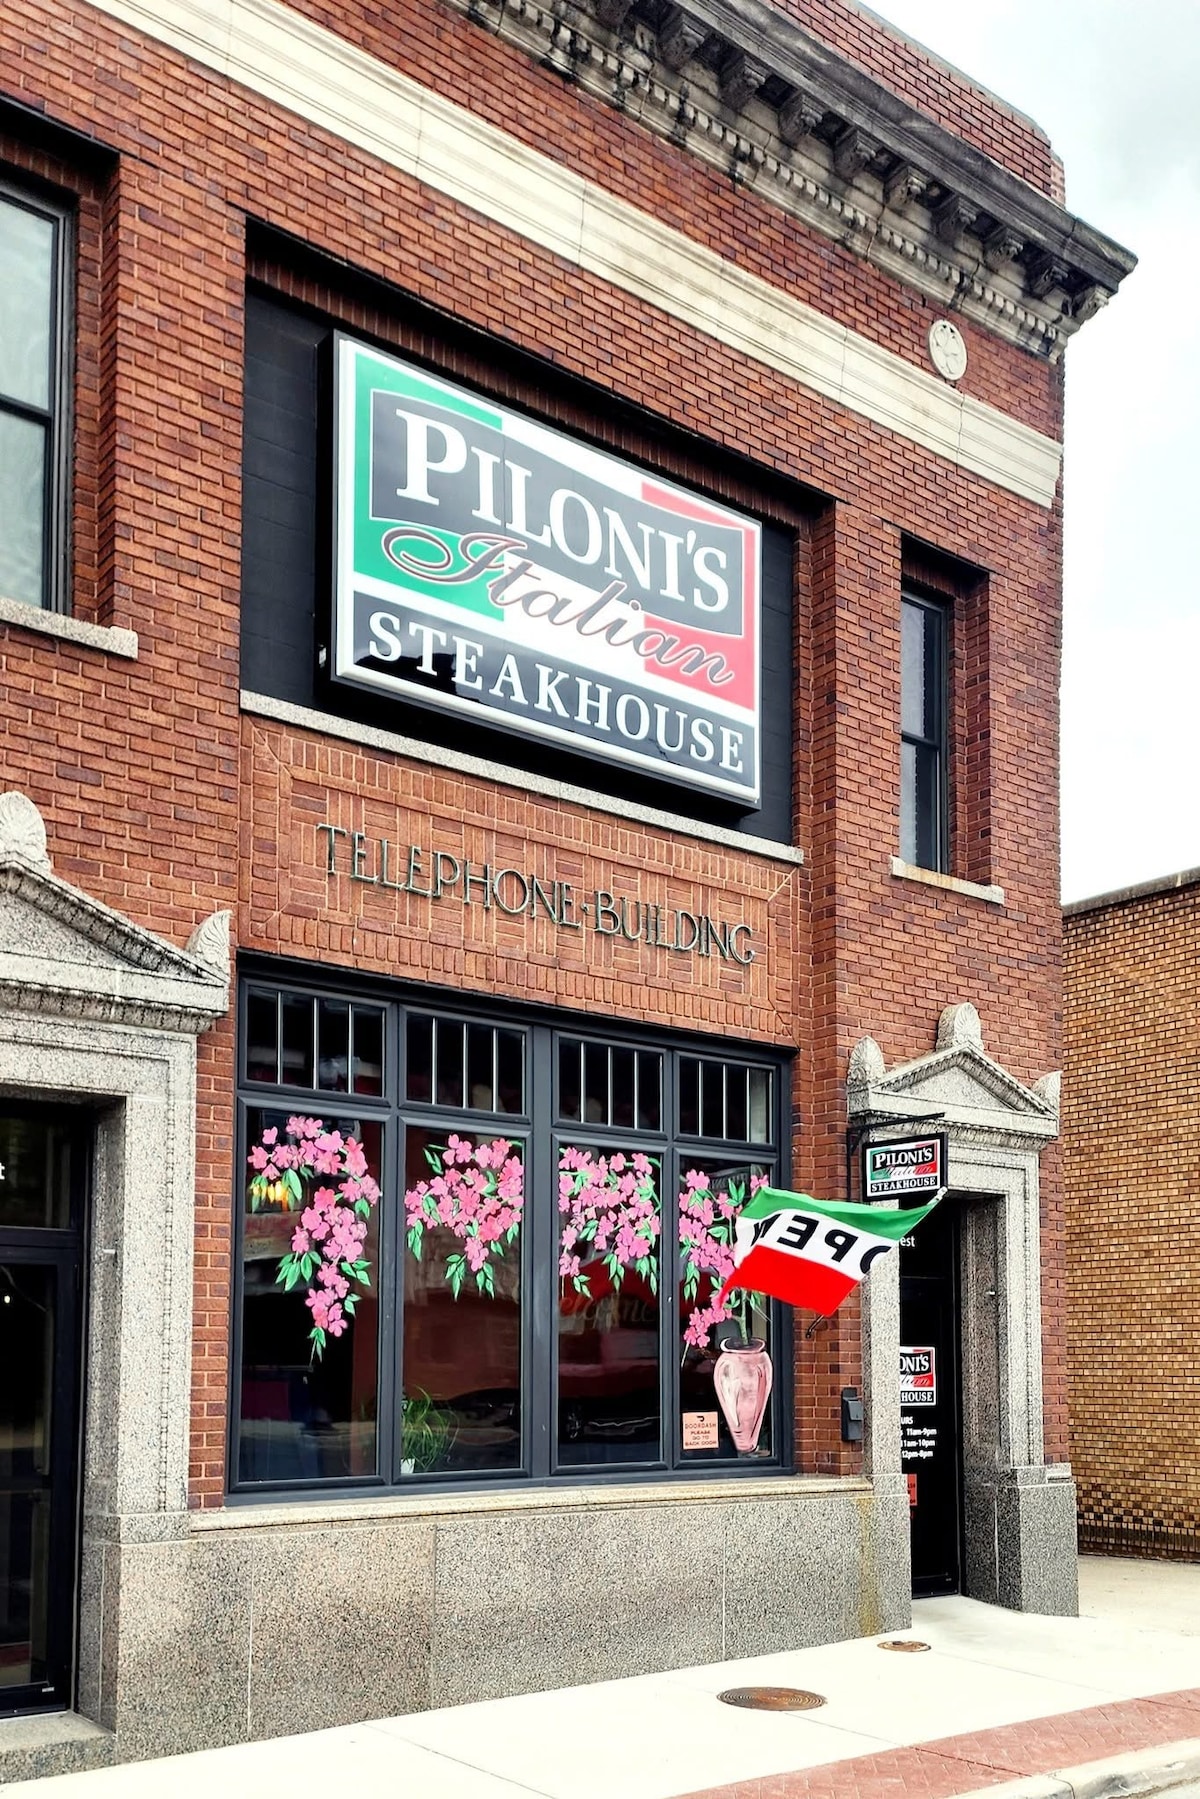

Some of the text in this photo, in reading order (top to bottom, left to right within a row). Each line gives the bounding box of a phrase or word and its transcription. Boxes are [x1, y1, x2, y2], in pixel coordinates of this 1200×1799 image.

[395, 408, 729, 612] PILONI'S
[381, 526, 735, 684] Italian
[368, 611, 744, 773] STEAKHOUSE
[316, 823, 755, 964] TELEPHONE BUILDING
[874, 1147, 933, 1169] PILONI'S
[871, 1177, 936, 1192] STEAKHOUSE
[900, 1235, 916, 1247] est
[900, 1354, 930, 1372] ONI'S
[901, 1391, 933, 1402] HOUSE
